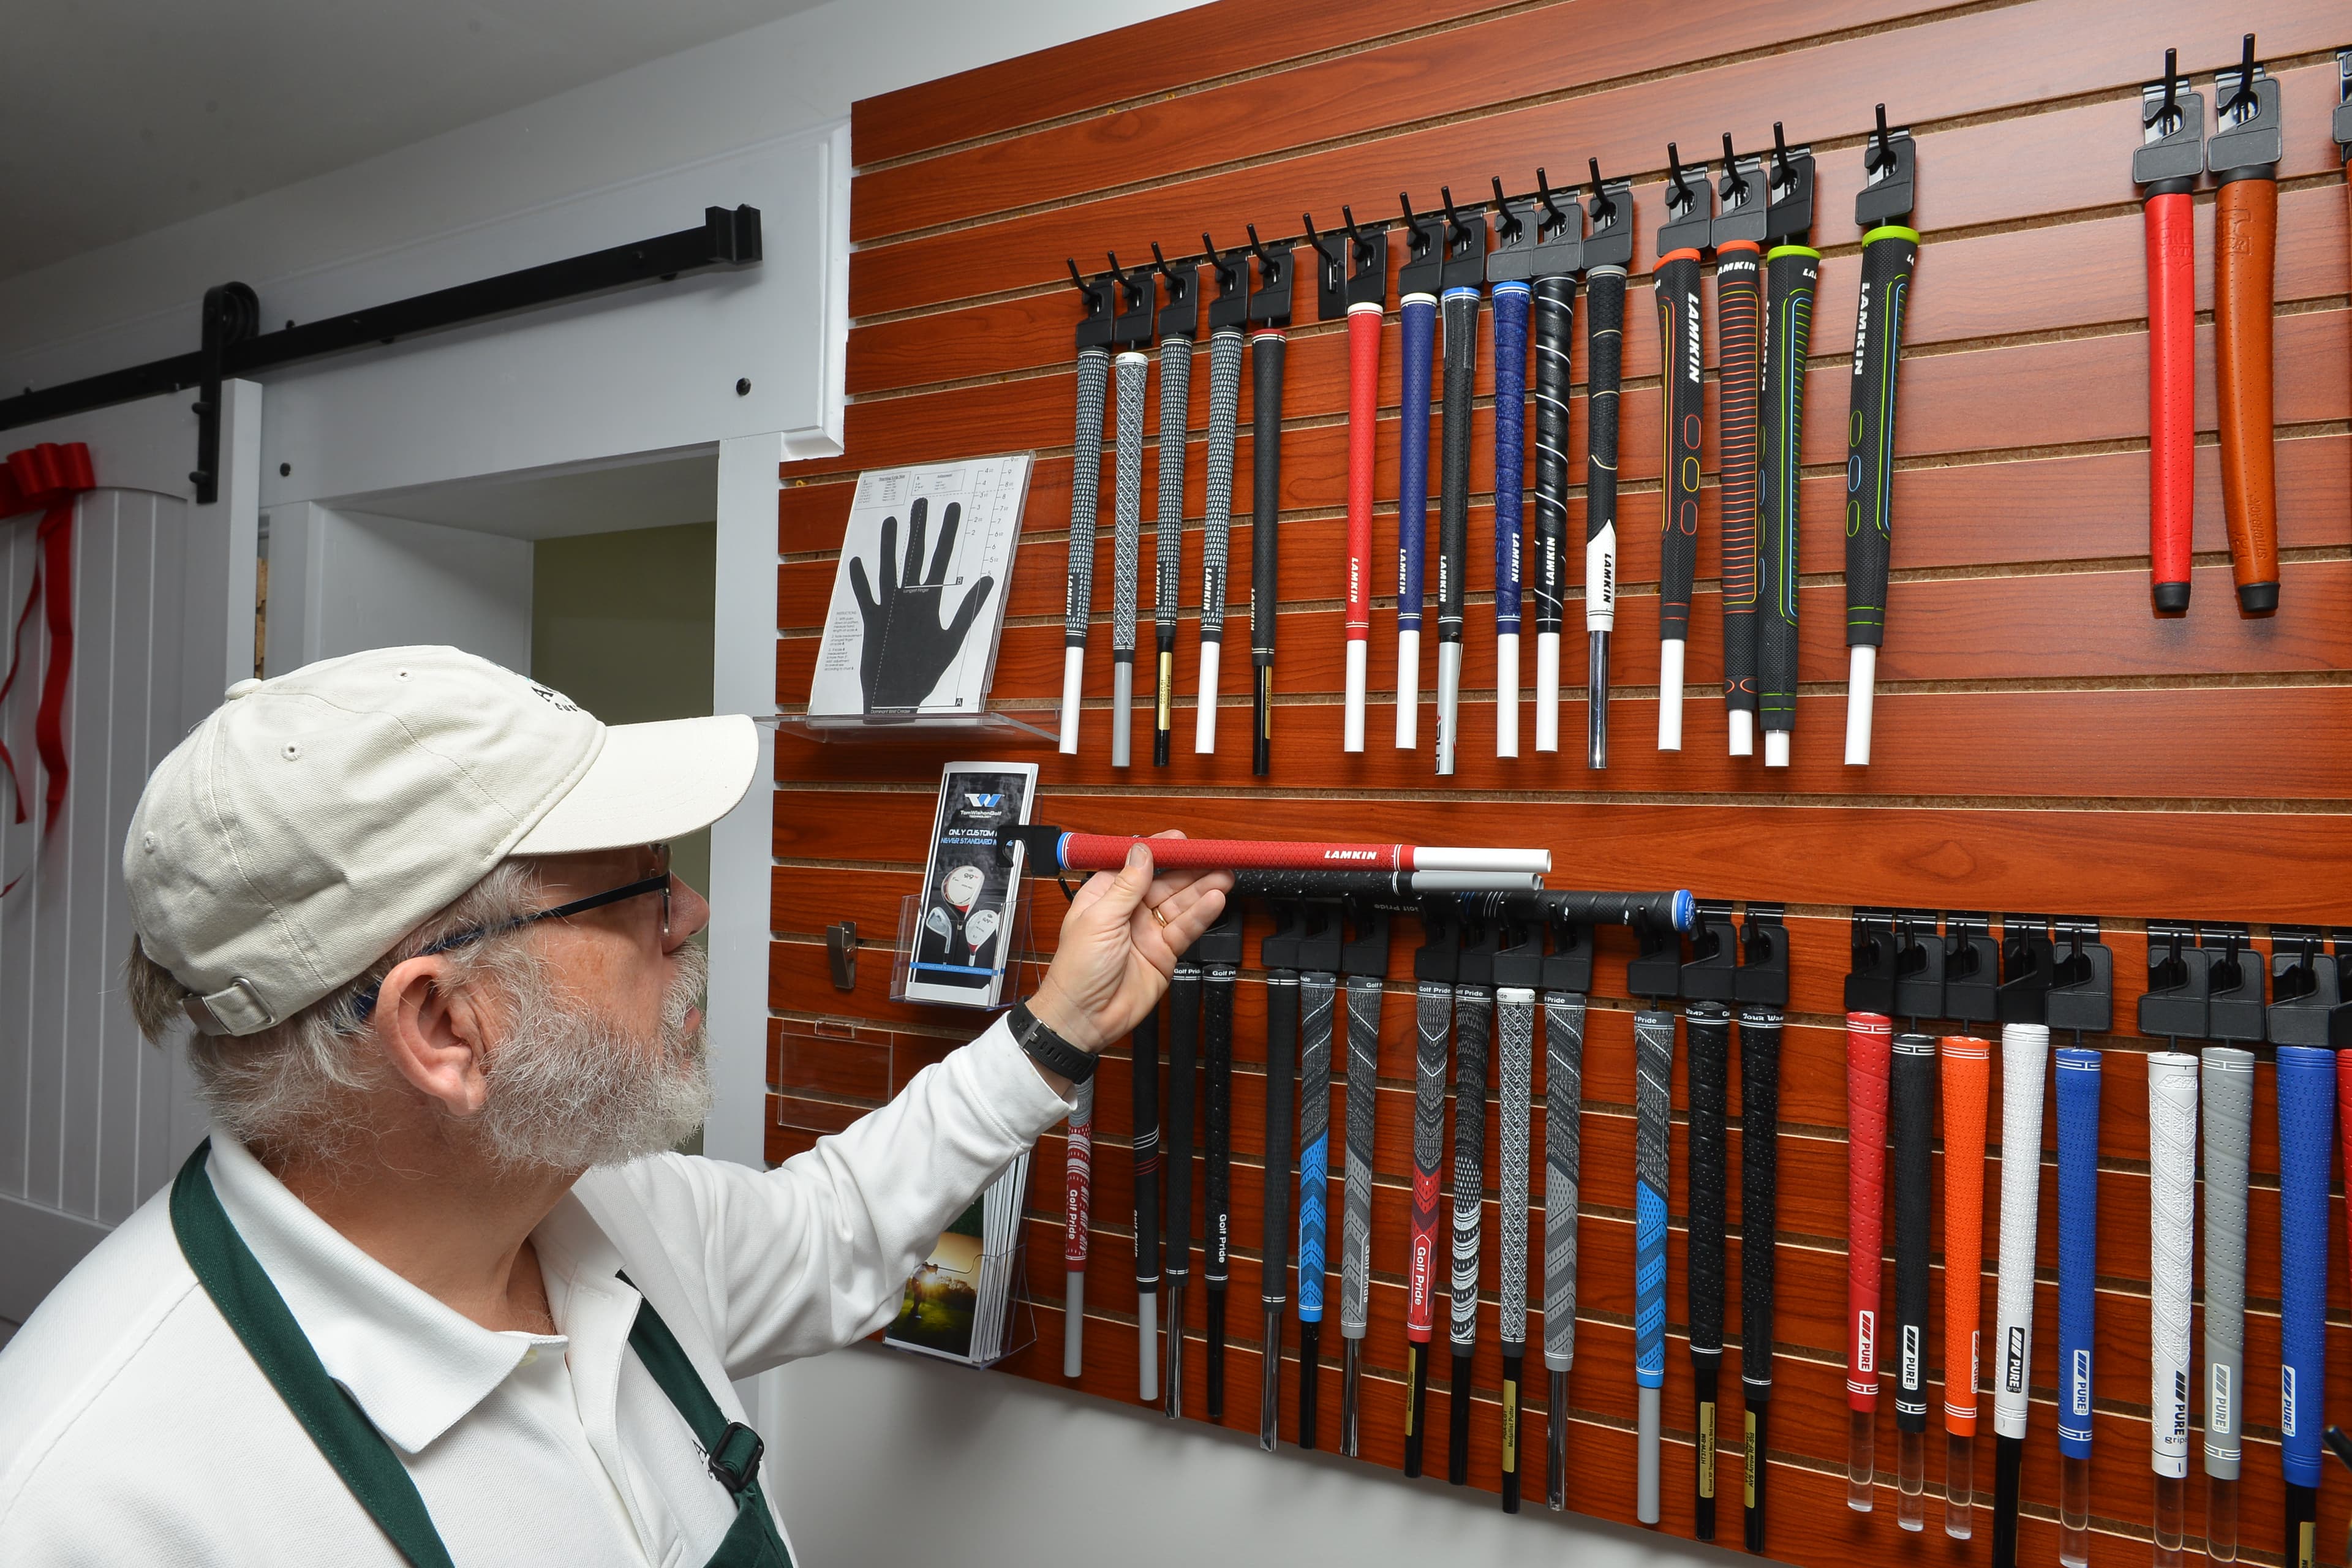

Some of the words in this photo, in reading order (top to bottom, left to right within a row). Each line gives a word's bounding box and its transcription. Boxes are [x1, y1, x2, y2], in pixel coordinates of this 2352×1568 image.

[1717, 261, 1755, 275] AMKIN
[1688, 292, 1699, 383] LAMKIN
[1855, 282, 1870, 374] LAMKIN
[1546, 537, 1555, 586] LAMKIN
[1204, 568, 1212, 610] LAMKIN
[1324, 850, 1378, 860] LAMKIN
[1069, 1189, 1078, 1211] Golf
[1416, 1246, 1426, 1272] Golf
[1415, 1275, 1425, 1306] Pride
[1861, 1343, 1870, 1370] PURE
[1906, 1356, 1915, 1384] PURE
[2010, 1359, 2021, 1387] PURE
[2078, 1382, 2087, 1409] PURE
[2174, 1404, 2185, 1435] PURE
[2216, 1397, 2226, 1427] PURE
[2283, 1398, 2292, 1430] PURE
